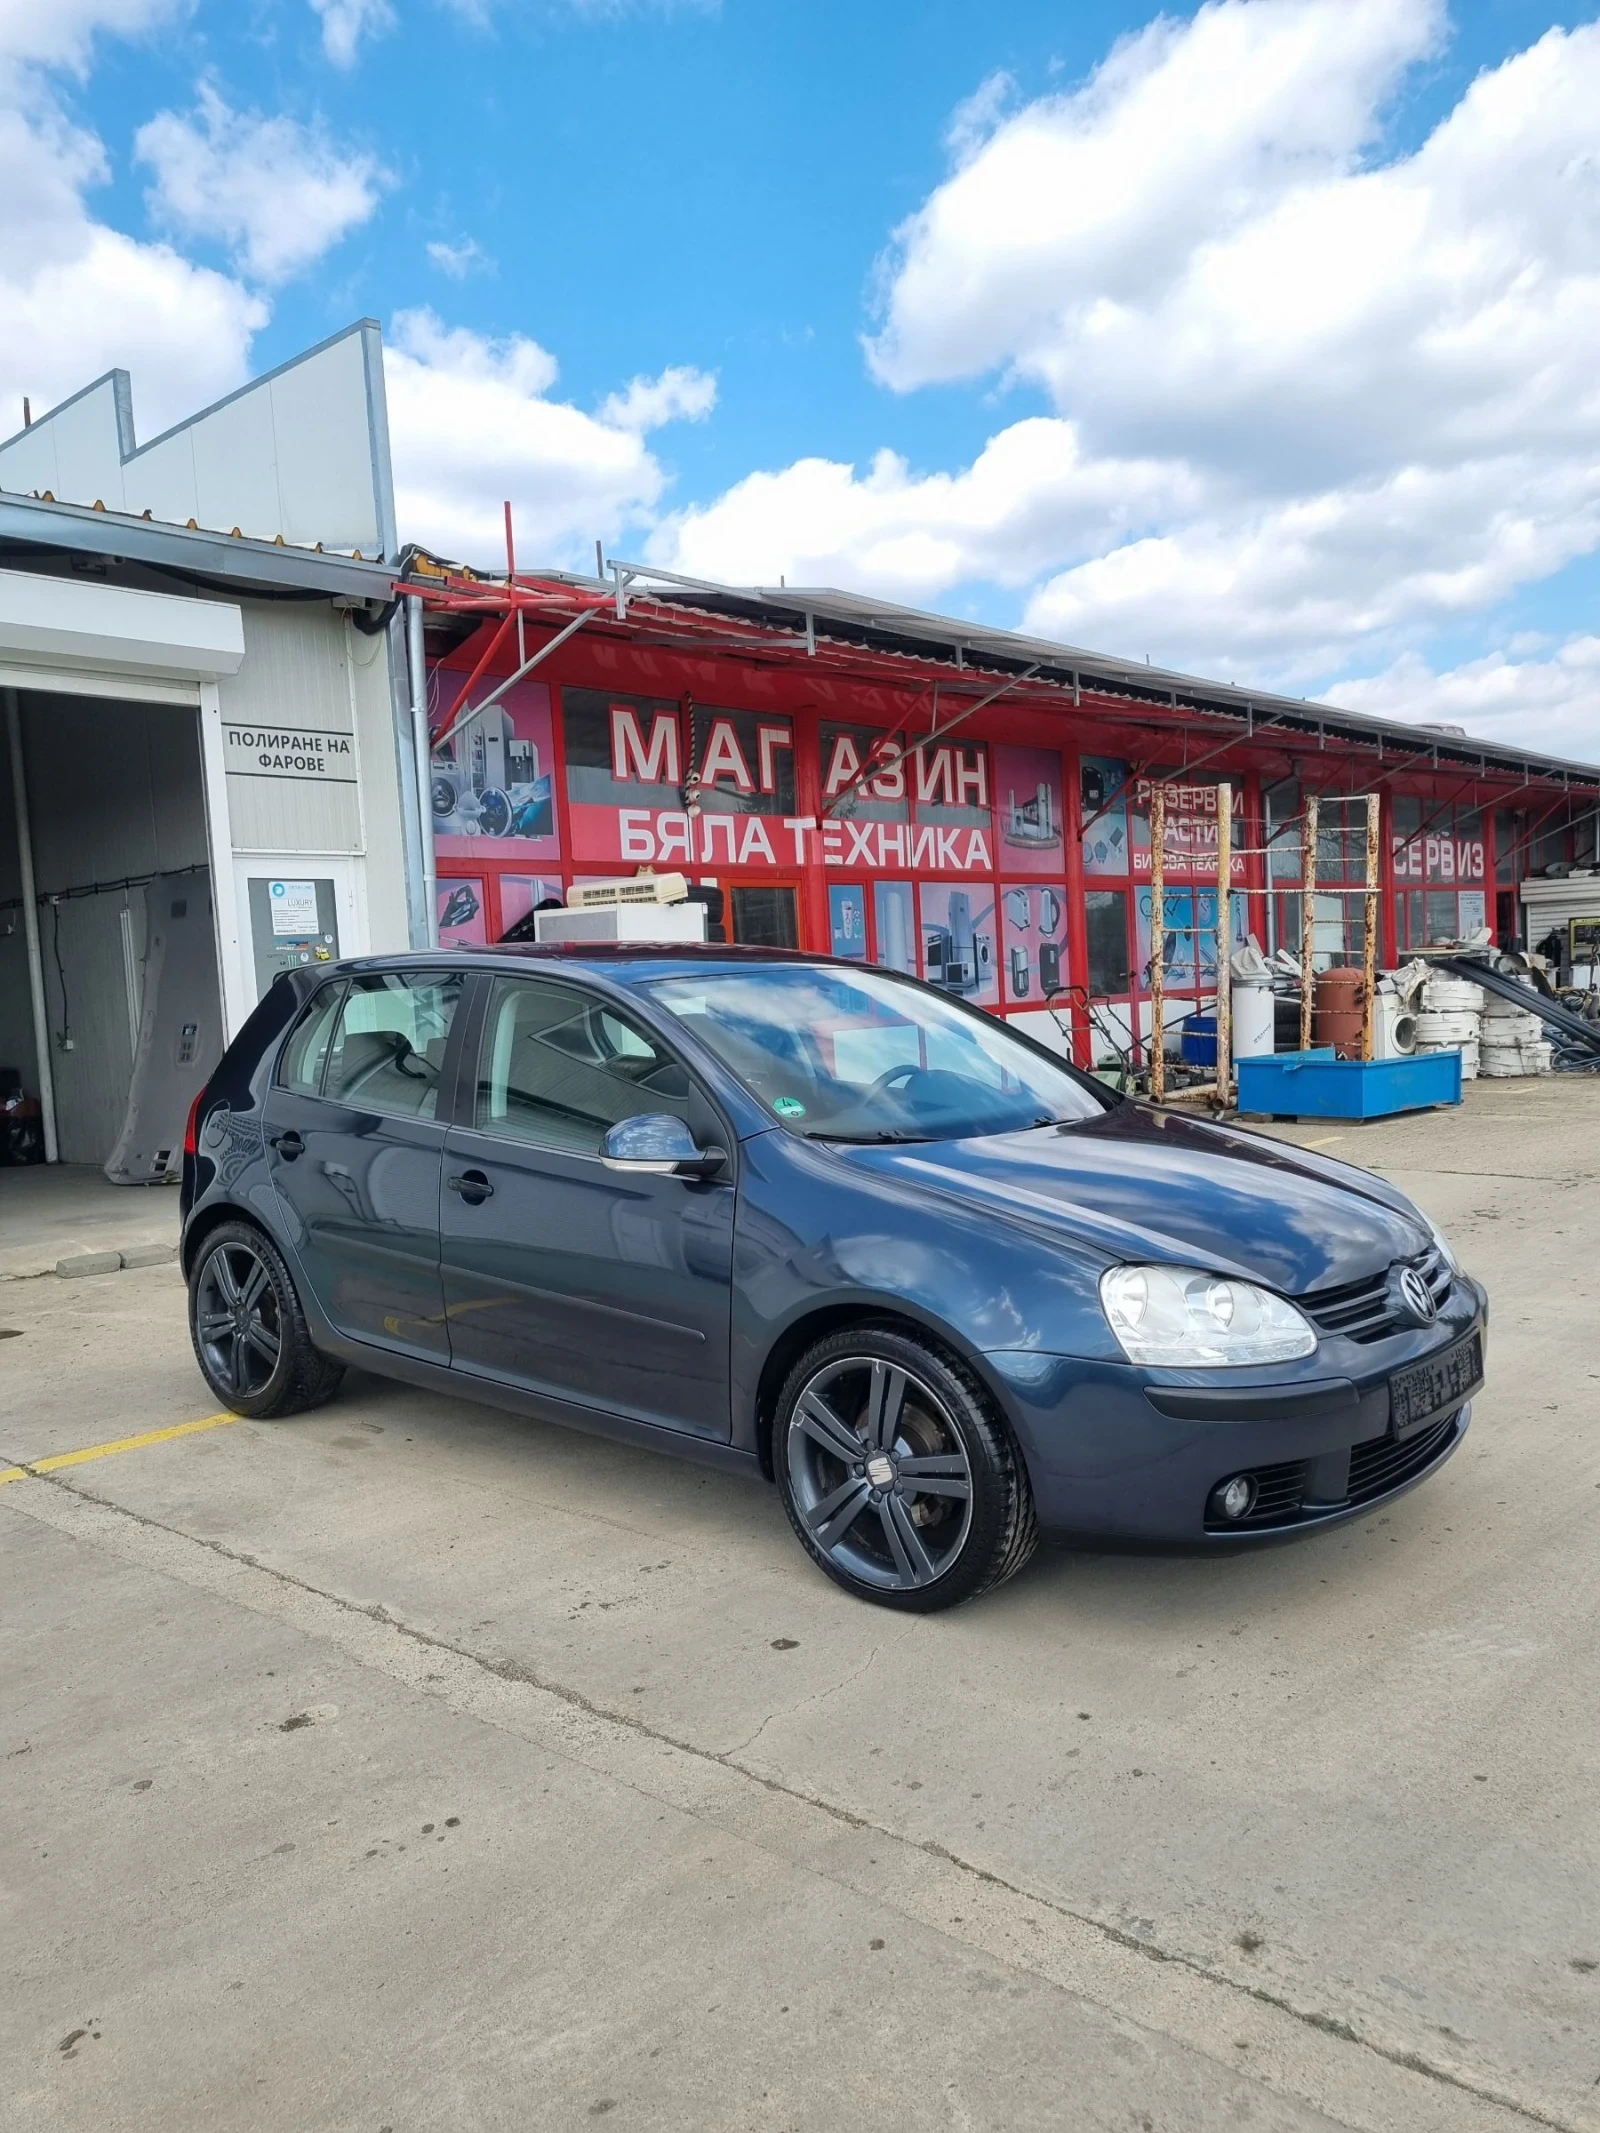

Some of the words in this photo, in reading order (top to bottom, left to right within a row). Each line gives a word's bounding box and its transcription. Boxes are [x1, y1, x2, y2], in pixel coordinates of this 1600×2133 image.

[228, 731, 324, 752] ПОЛИРАНЕ
[327, 739, 351, 754] НА
[258, 753, 326, 772] ФАРОВЕ
[1136, 779, 1244, 815] РЗЕРВИ
[618, 808, 777, 865] БЯЛА
[783, 816, 993, 871] ТЕХНИКА
[1149, 814, 1219, 843] АСТИ
[1133, 853, 1187, 870] БИОВА
[1191, 855, 1245, 872] ТЕХНКА
[1392, 836, 1485, 878] СЕРВИЗ
[287, 898, 313, 906] LUXURY
[782, 1098, 792, 1107] 4
